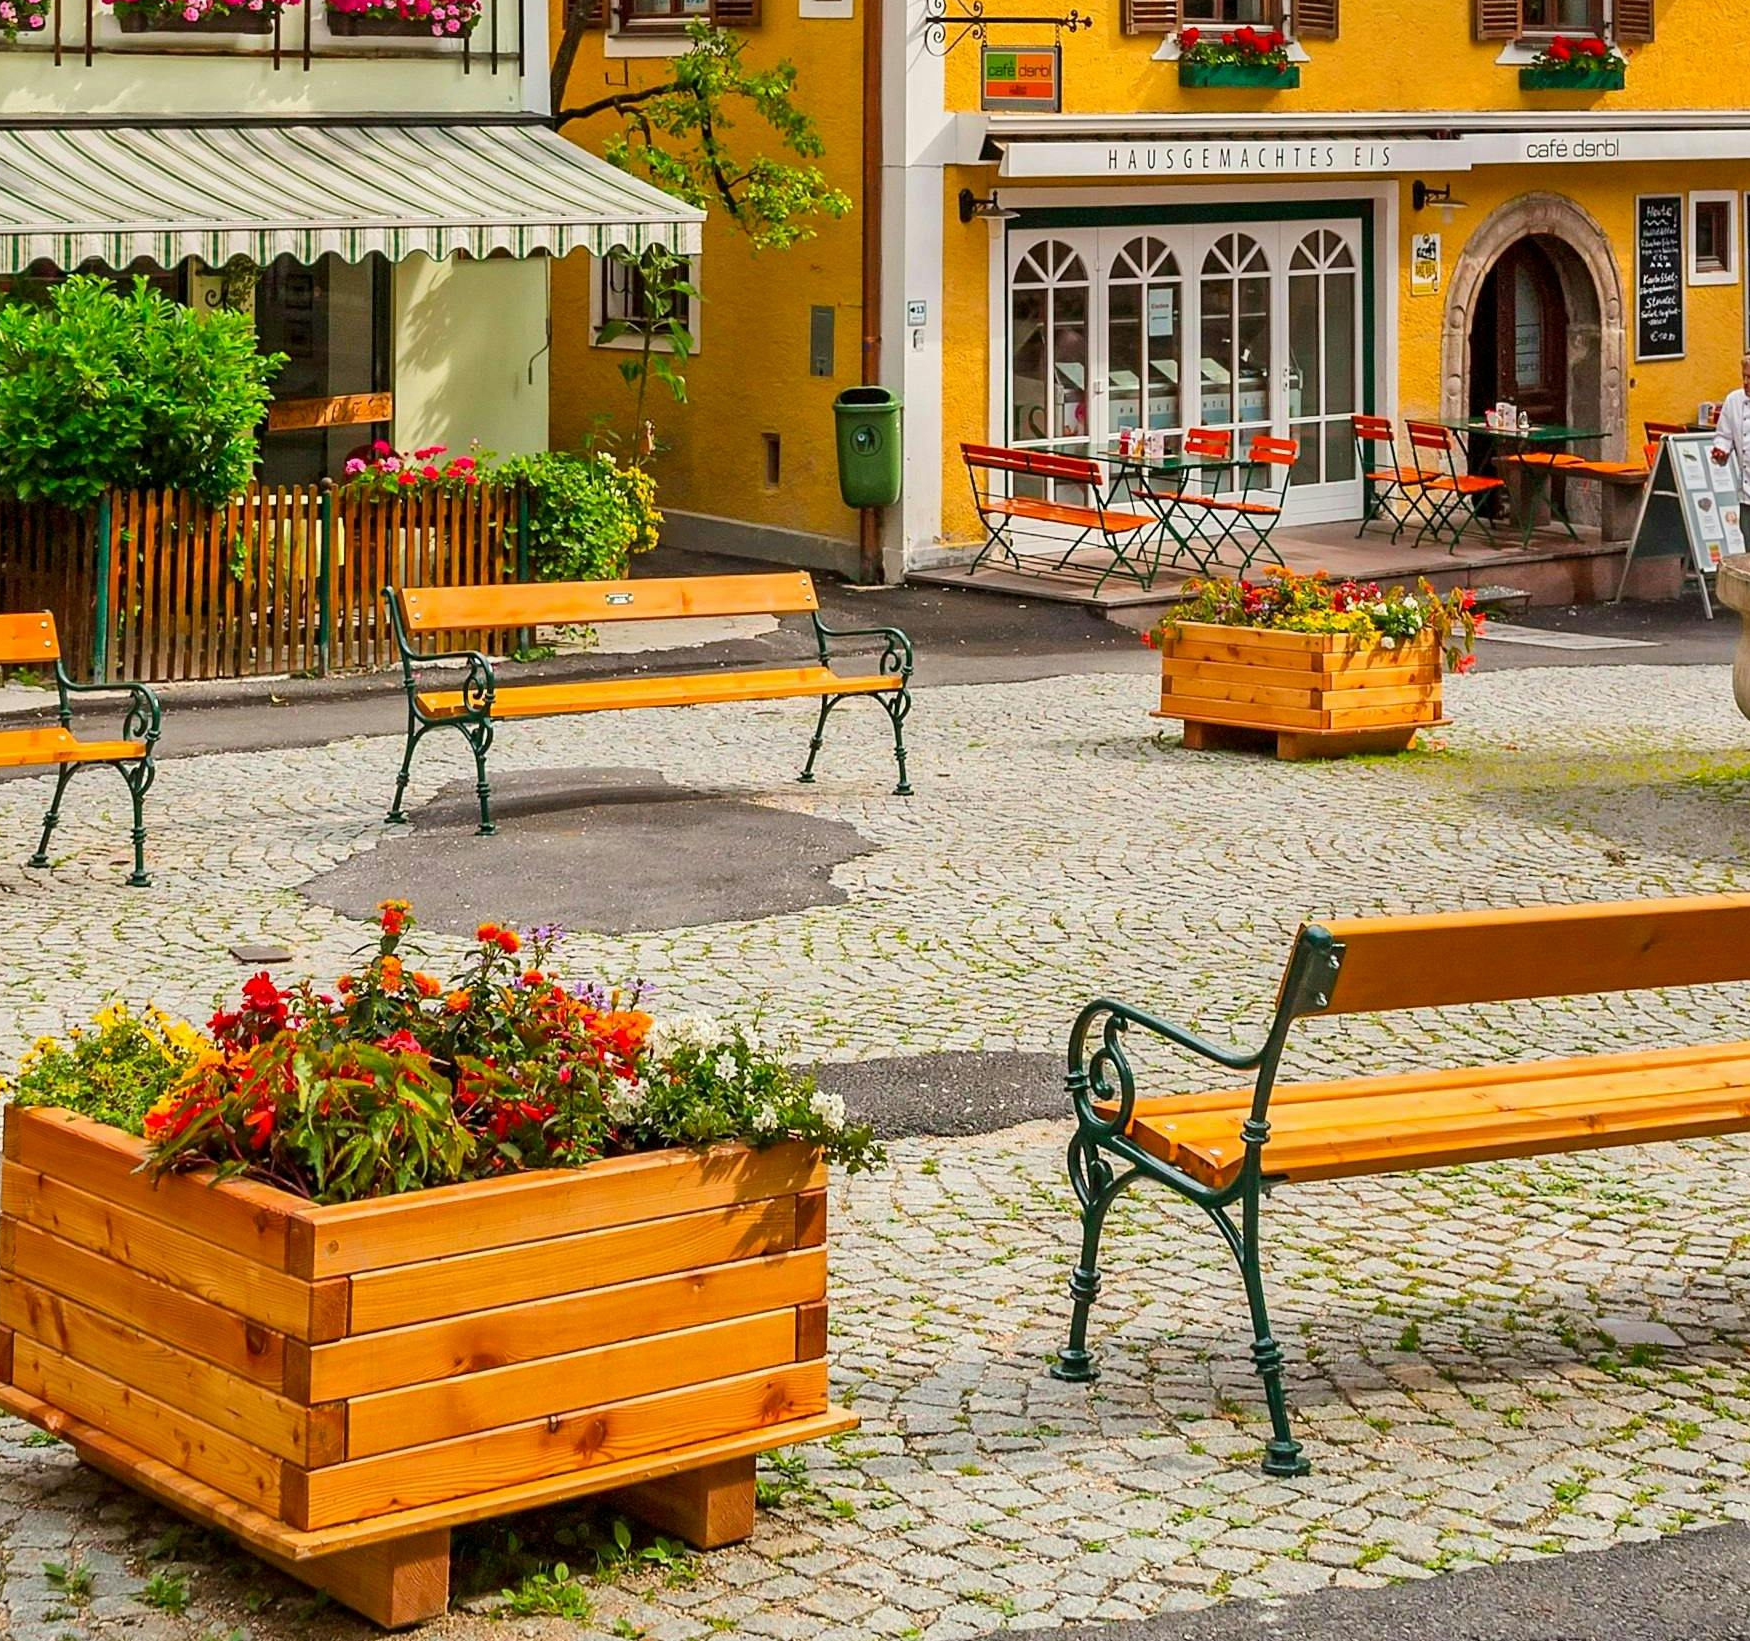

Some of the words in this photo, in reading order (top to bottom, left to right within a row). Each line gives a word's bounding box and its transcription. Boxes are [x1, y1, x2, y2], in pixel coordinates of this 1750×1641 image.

[1108, 147, 1334, 169] HAUSGEMACHTES
[1354, 146, 1391, 166] EIS
[1526, 139, 1568, 158] café
